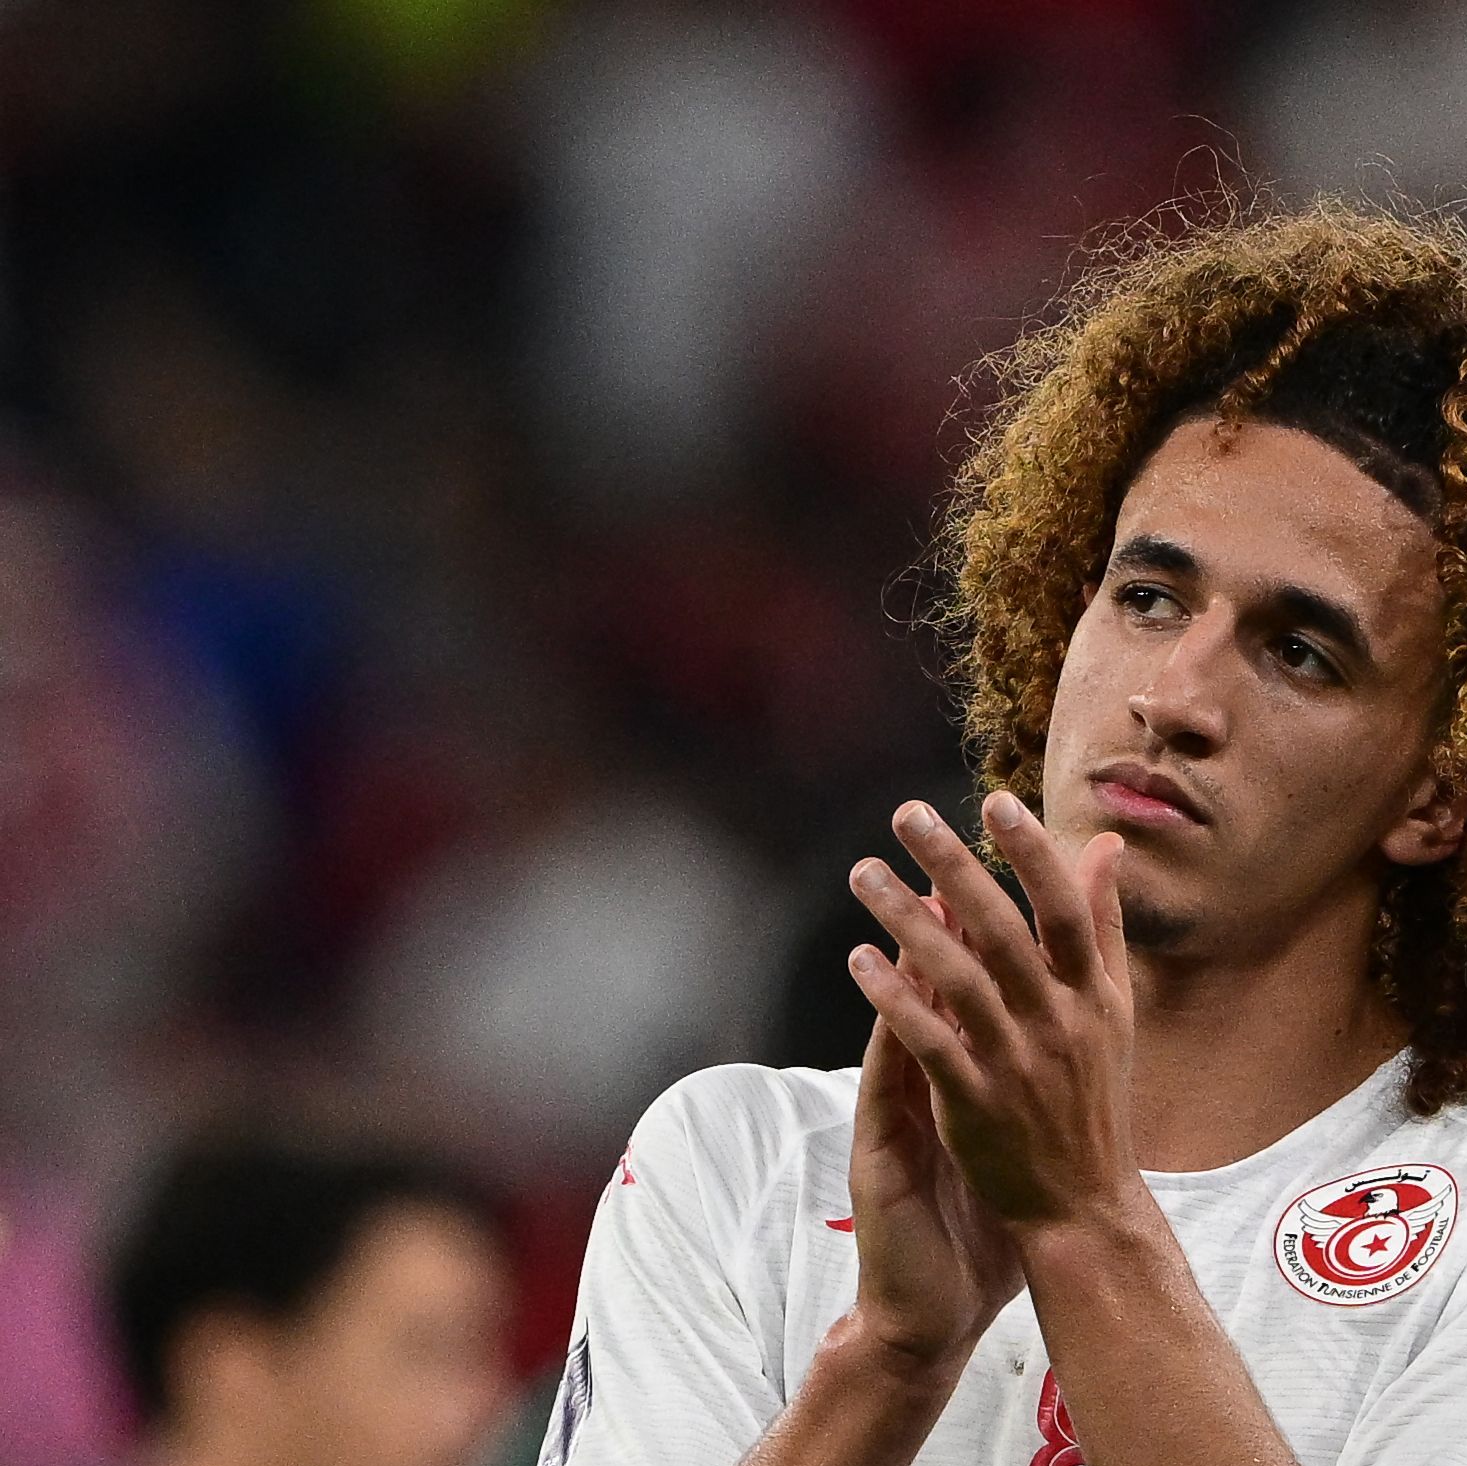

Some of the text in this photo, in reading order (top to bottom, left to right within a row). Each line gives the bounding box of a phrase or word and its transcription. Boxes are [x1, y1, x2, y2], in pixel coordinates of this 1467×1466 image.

[1283, 1217, 1450, 1299] FEDERATION TUNISIENNE DE FOOTBALL
